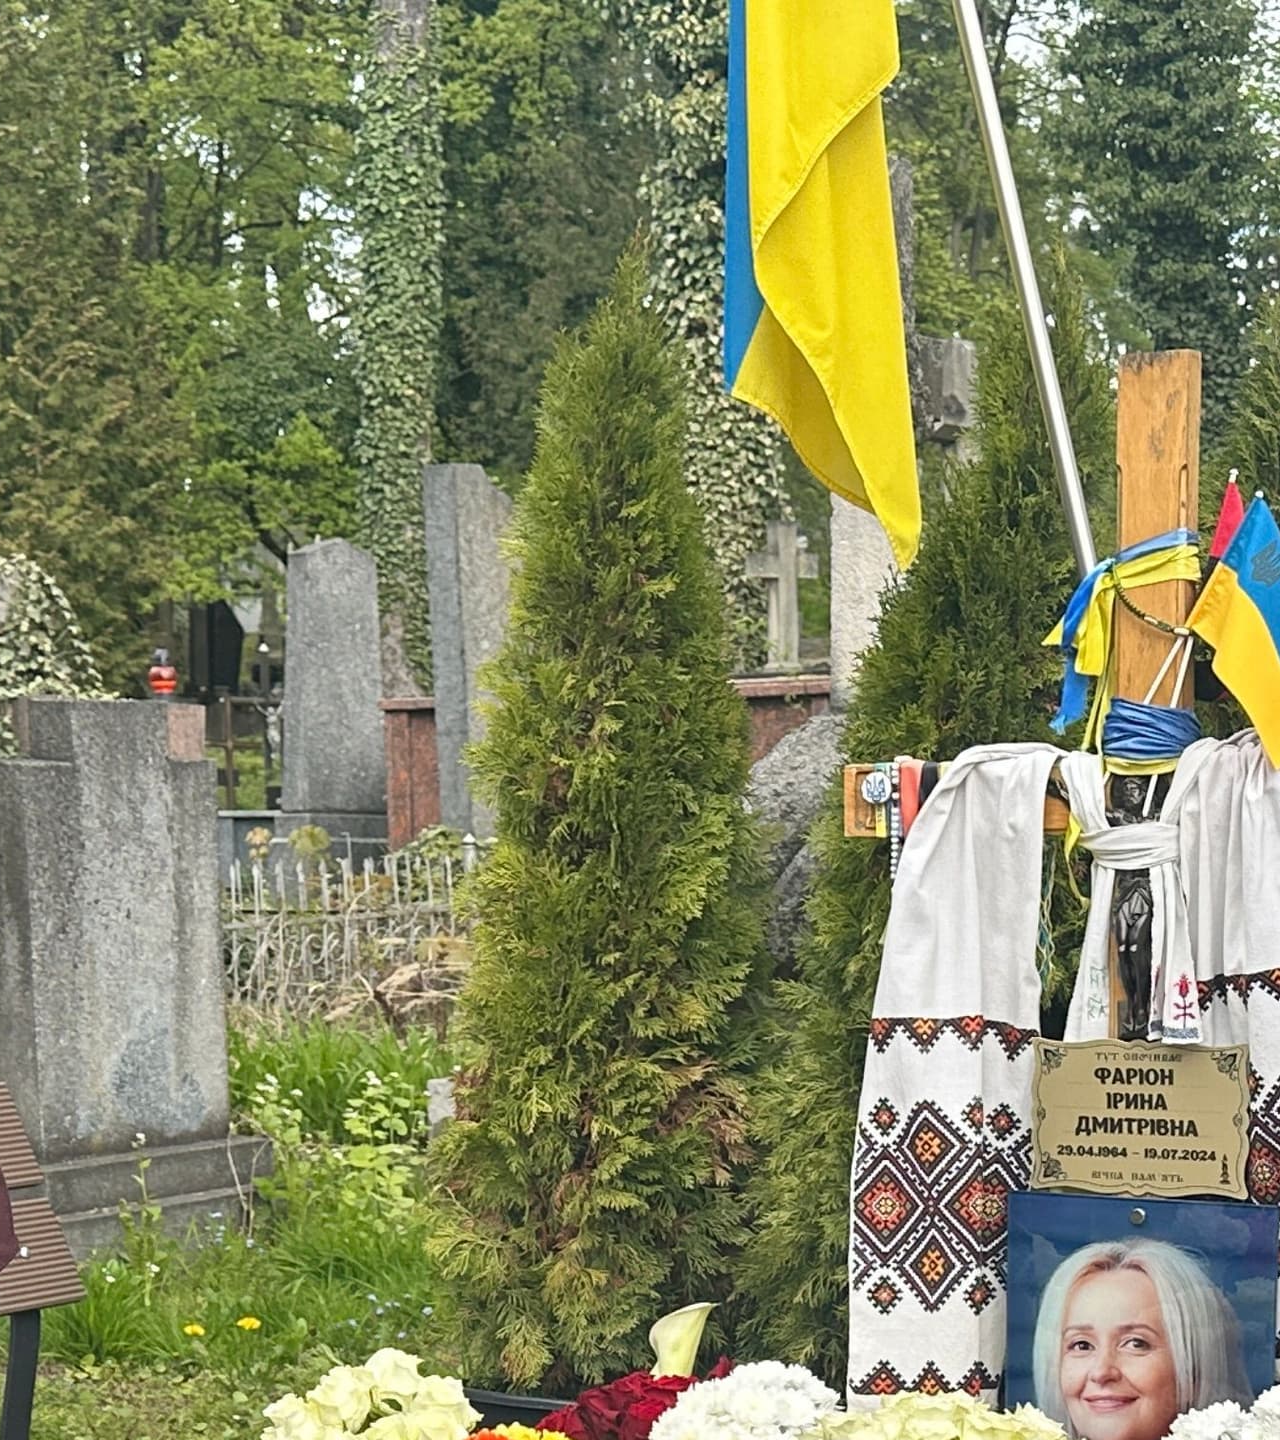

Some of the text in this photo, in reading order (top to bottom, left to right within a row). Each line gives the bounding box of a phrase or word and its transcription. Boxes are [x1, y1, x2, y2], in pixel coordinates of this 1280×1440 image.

[1094, 1067, 1175, 1086] ФАРІОН
[1106, 1091, 1168, 1111] ІРИНА
[1074, 1115, 1199, 1137] ДМИТРІВНА
[1056, 1143, 1128, 1159] 29.04.1964
[1144, 1147, 1217, 1162] 19.07.2024
